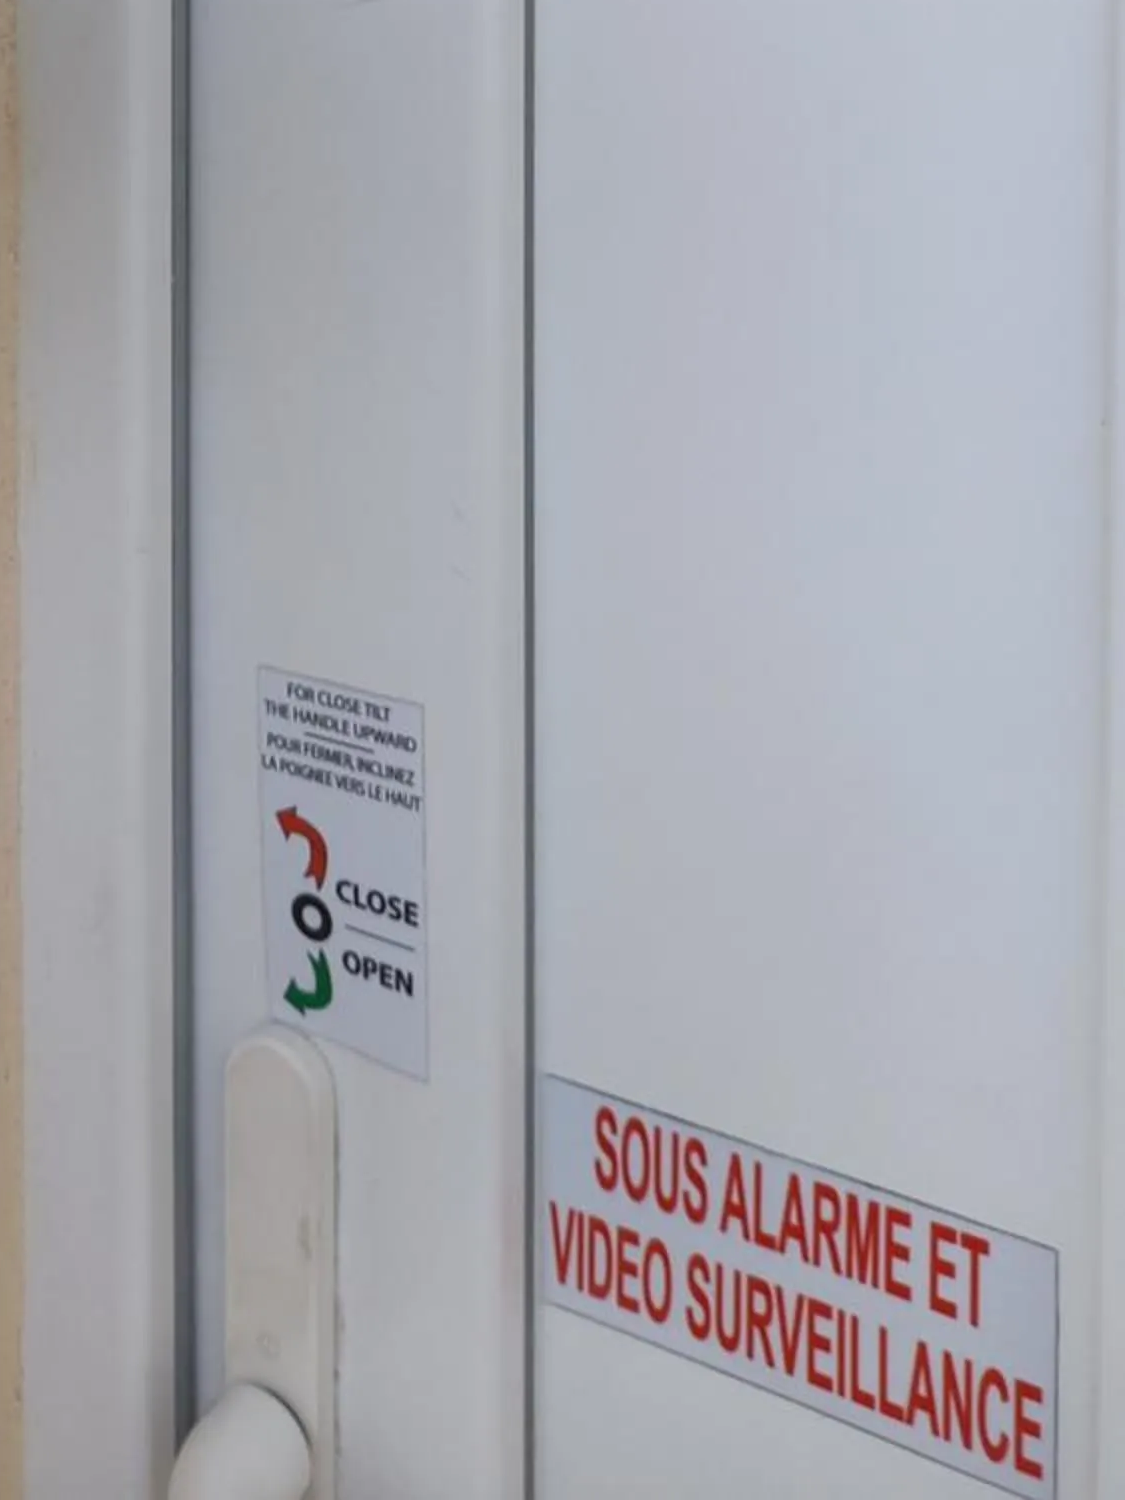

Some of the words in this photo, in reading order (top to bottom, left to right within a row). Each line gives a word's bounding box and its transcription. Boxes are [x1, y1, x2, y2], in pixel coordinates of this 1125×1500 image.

[264, 698, 289, 720] THE
[292, 705, 350, 736] HANDLE
[353, 723, 418, 752] UPWARD
[286, 682, 314, 702] FOR
[317, 690, 361, 715] CLOSE
[365, 701, 391, 722] TILT
[261, 754, 277, 772] LA
[333, 773, 366, 797] VERS
[368, 783, 381, 802] LE
[384, 788, 422, 812] HAUT
[266, 732, 301, 754] POUR
[356, 757, 415, 787] INCLINEZ
[335, 879, 420, 929] CLOSE
[341, 950, 414, 997] OPEN
[594, 1105, 708, 1225] SOUS
[719, 1151, 913, 1302] ALARME
[929, 1220, 990, 1329] ET
[549, 1200, 673, 1325] VIDEO
[686, 1252, 1044, 1482] SURVEILLANCE
